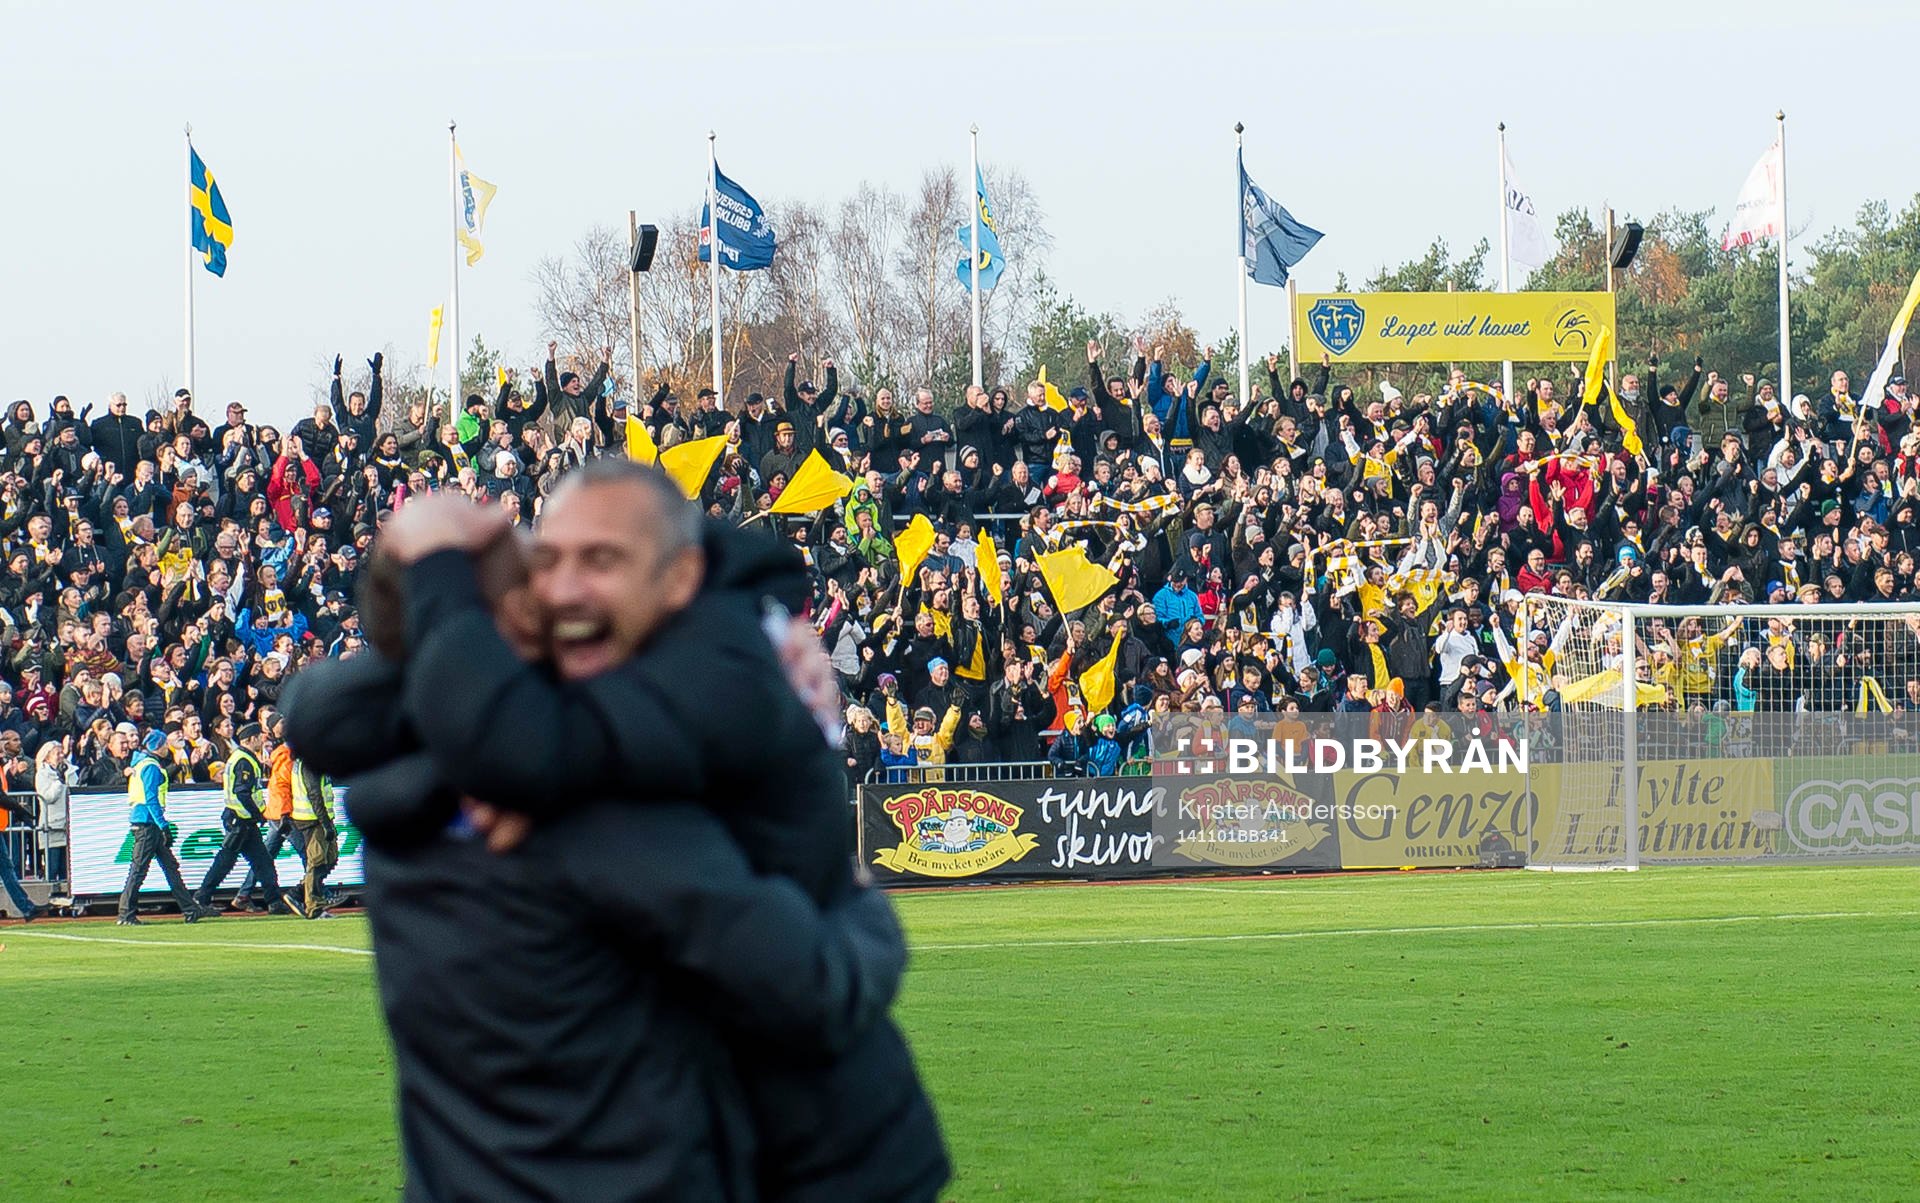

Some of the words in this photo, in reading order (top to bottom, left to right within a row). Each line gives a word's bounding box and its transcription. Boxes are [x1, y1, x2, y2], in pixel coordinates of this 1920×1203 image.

[1380, 315, 1438, 346] Laget
[1444, 315, 1476, 336] vid
[1479, 315, 1531, 336] havet
[886, 790, 1020, 840] PÄRSONS
[1036, 787, 1168, 823] tunna
[1183, 781, 1312, 828] PÄRSONS
[1345, 773, 1540, 850] Genzo
[1051, 812, 1165, 868] skivor
[1229, 847, 1267, 860] mycket
[908, 851, 928, 868] Bra
[931, 859, 973, 871] mycket
